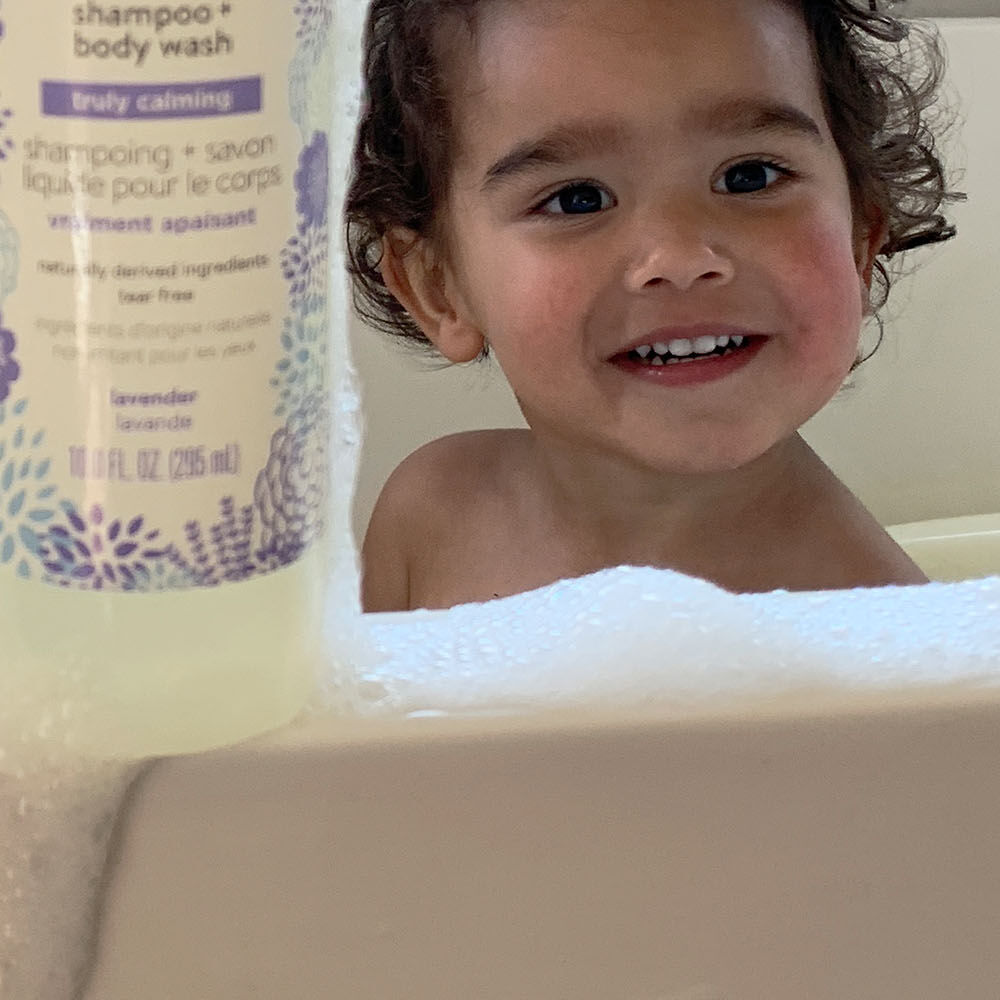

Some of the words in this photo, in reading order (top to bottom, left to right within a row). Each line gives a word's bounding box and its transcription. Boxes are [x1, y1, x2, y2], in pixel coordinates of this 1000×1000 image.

[73, 30, 150, 67] body
[159, 29, 233, 57] wash
[72, 90, 129, 115] truly
[136, 89, 233, 113] calming
[205, 134, 277, 164] savon
[112, 174, 178, 206] pour
[187, 169, 210, 197] le
[216, 164, 283, 195] corps
[161, 207, 257, 234] apaisant
